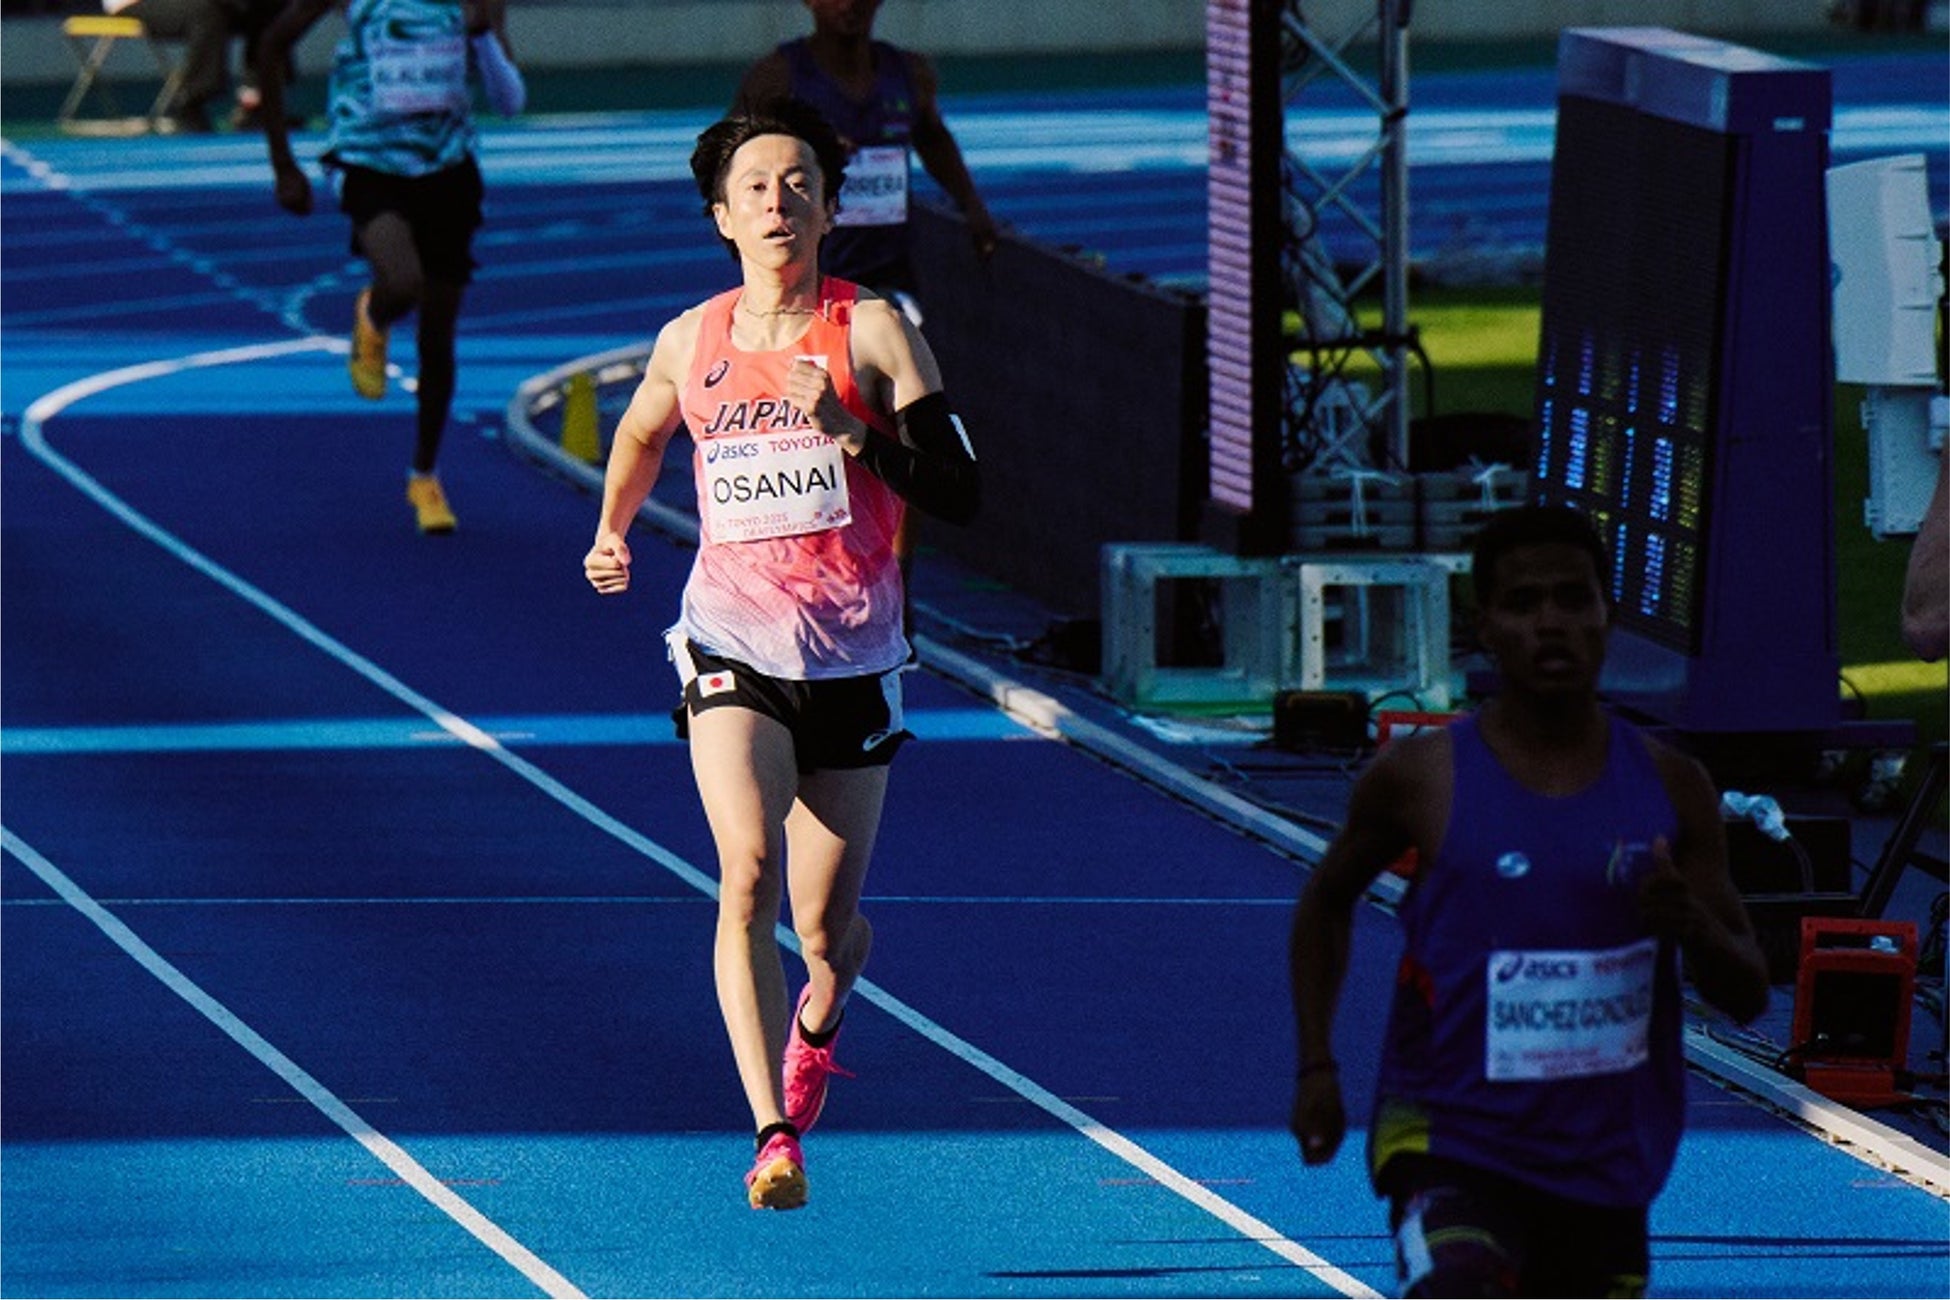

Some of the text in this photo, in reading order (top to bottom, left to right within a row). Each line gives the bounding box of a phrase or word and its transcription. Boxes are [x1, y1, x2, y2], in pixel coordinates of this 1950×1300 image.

[722, 436, 835, 459] asics TOYOTA
[714, 464, 837, 504] OSANAI
[728, 515, 761, 528] TOKYO
